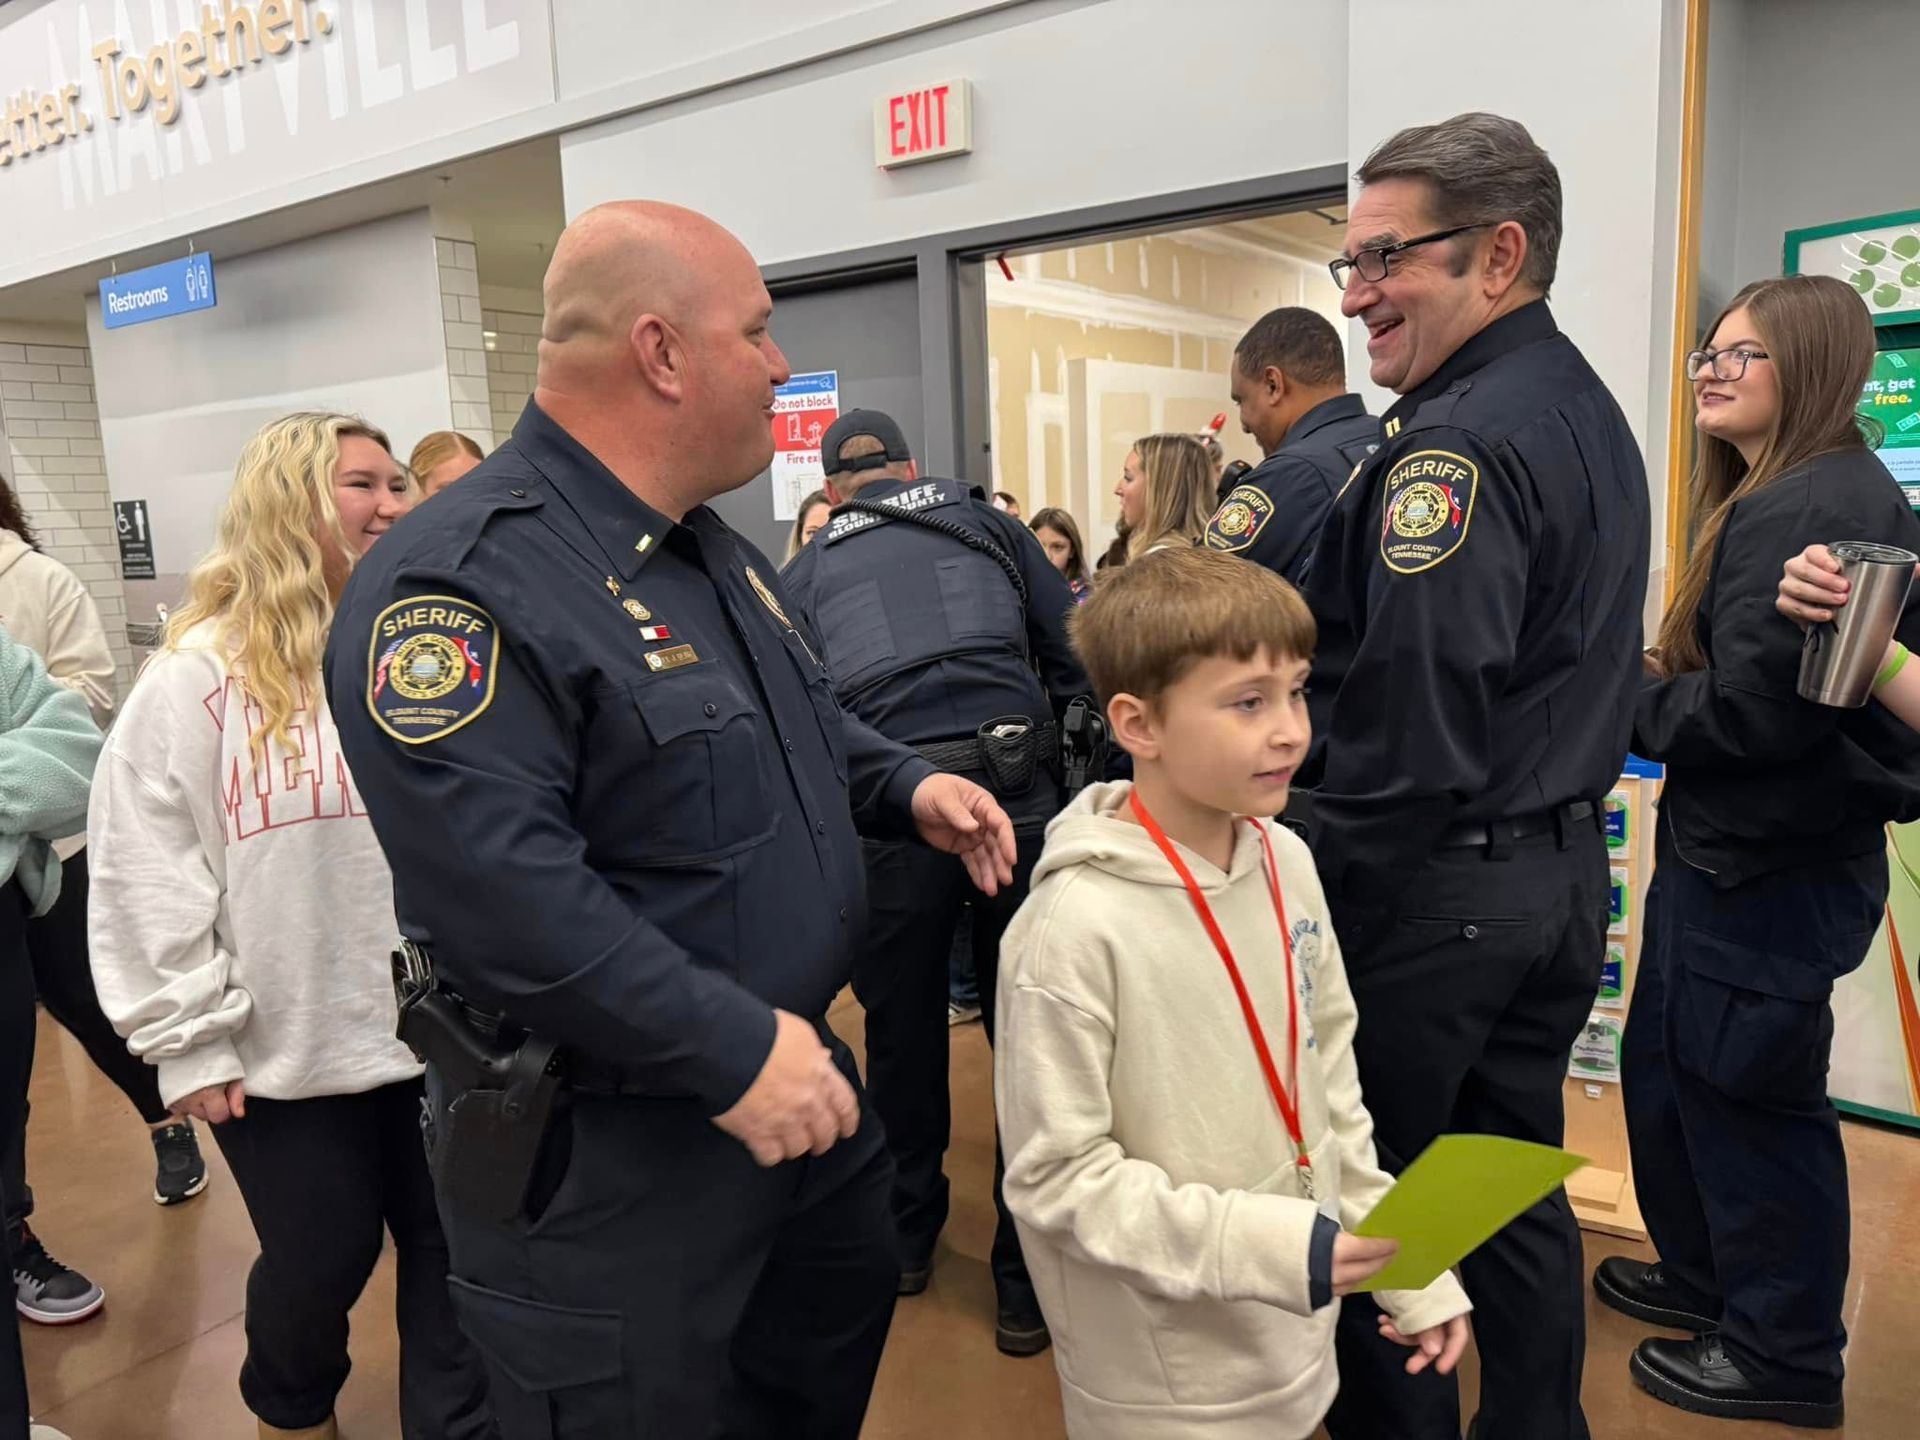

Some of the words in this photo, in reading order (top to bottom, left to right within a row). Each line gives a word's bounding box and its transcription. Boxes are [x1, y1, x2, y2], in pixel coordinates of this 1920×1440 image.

[92, 0, 334, 126] Together.
[46, 0, 520, 211] MARVILL
[889, 86, 949, 157] EXIT
[107, 285, 169, 315] Restrooms
[1874, 393, 1913, 405] free.
[1887, 377, 1917, 393] get
[773, 398, 787, 410] Do
[788, 397, 805, 409] not
[806, 393, 834, 407] block
[786, 452, 805, 465] Fire
[1391, 460, 1468, 490] SHERIFF
[832, 483, 937, 530] SHRIFF
[1231, 490, 1268, 512] SHERIFF
[828, 512, 882, 539] BLOUN
[383, 607, 487, 637] SHERIFF
